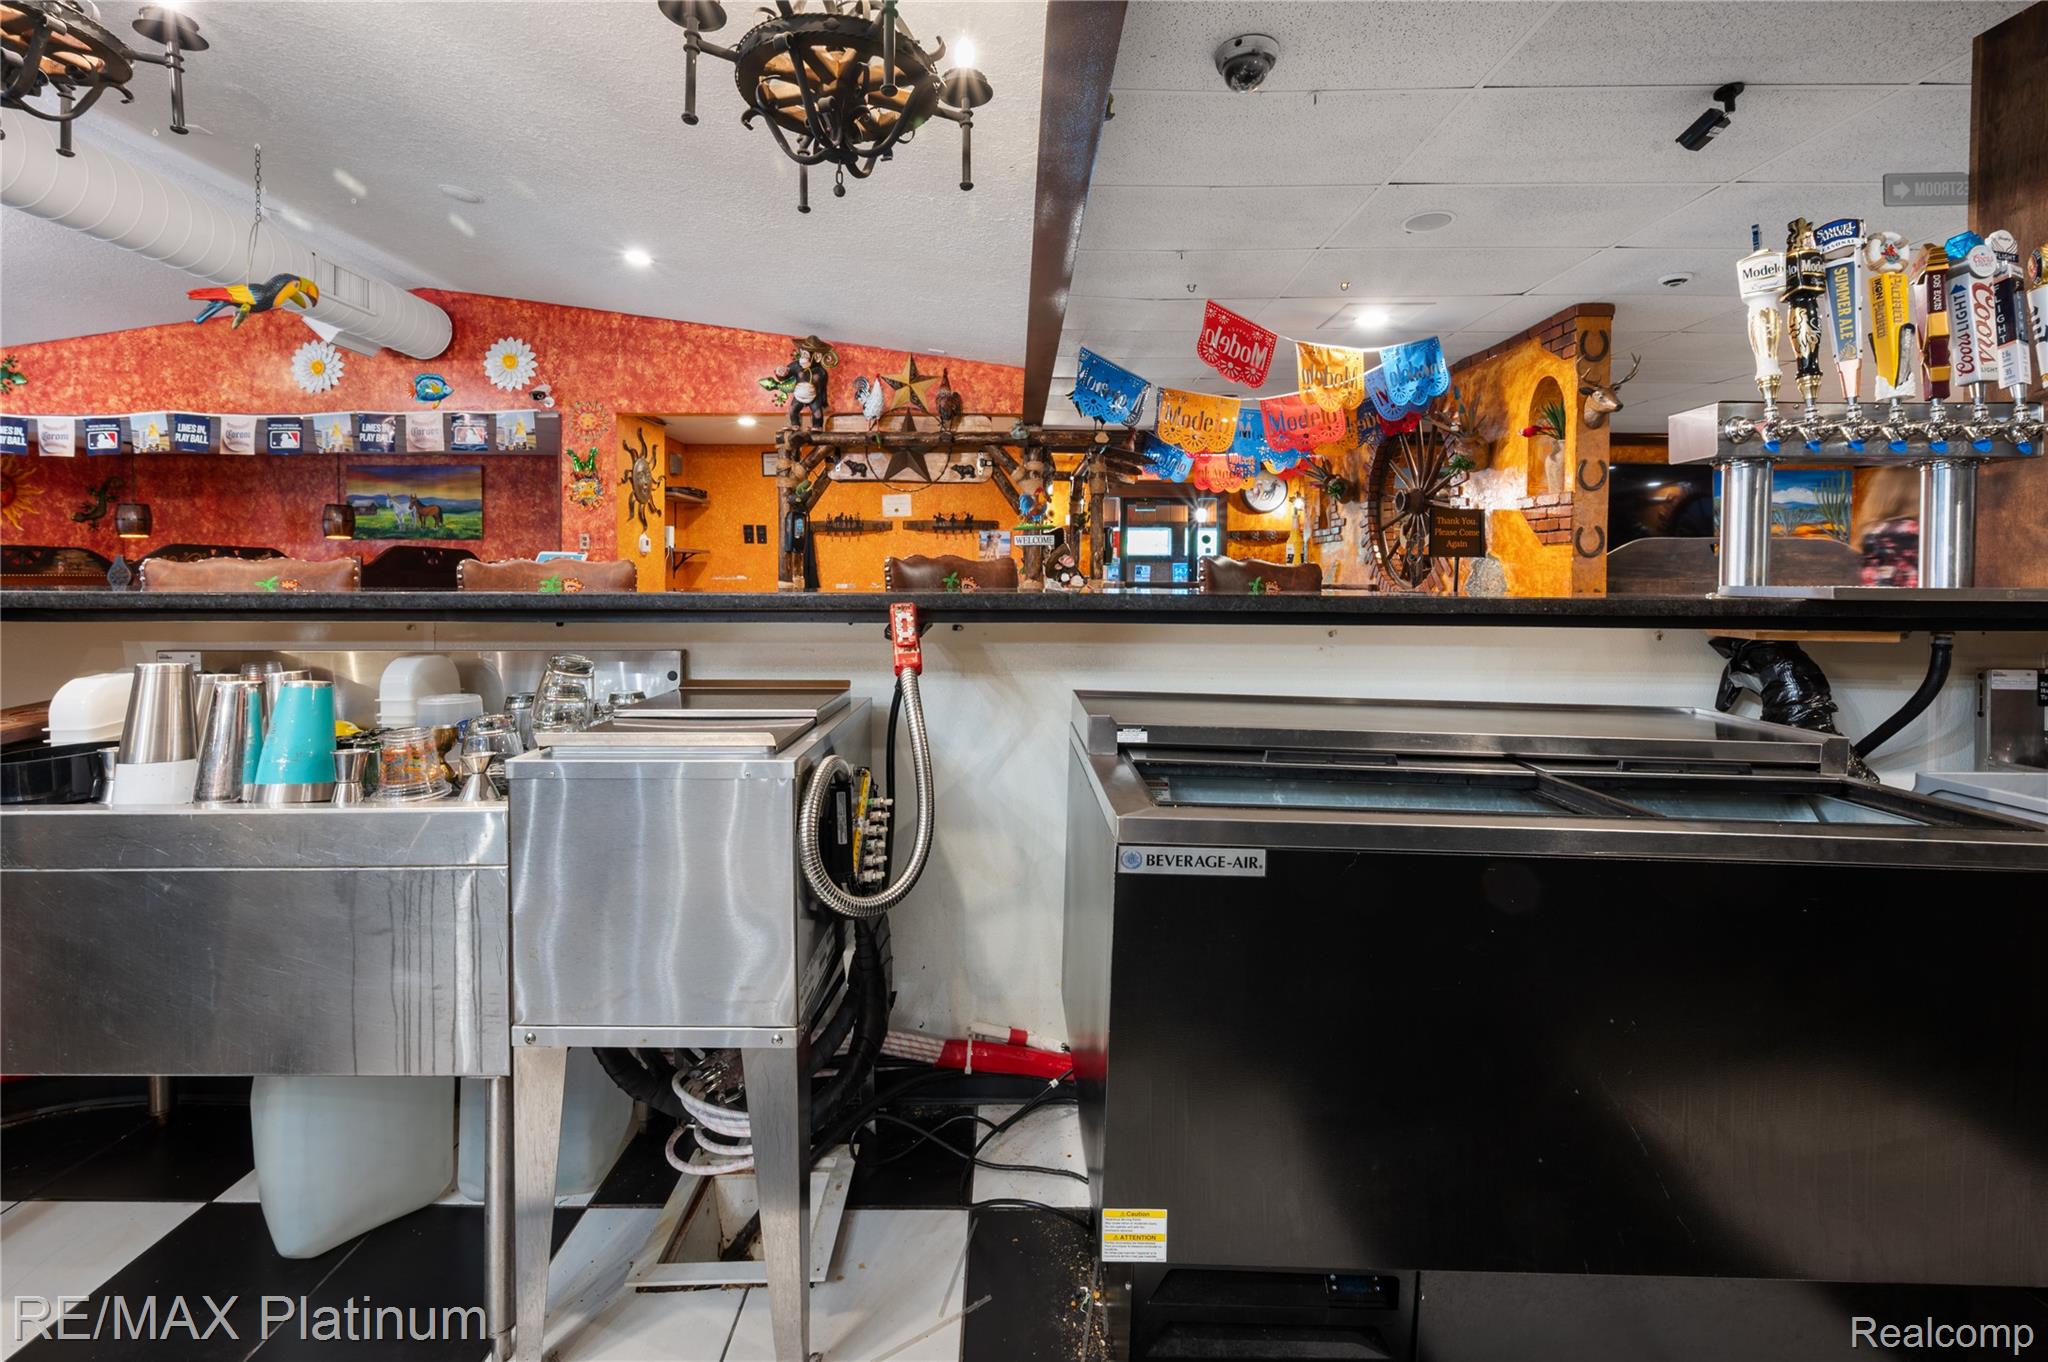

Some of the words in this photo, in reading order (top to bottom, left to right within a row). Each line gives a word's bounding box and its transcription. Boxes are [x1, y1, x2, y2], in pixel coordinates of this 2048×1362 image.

[1816, 221, 1856, 239] SAMUEL
[1820, 229, 1854, 243] ADAMS
[1743, 263, 1784, 279] Modelo
[1932, 274, 1942, 288] DOS
[1834, 266, 1852, 316] SUMMER
[1933, 290, 1942, 311] EQUIS
[1955, 293, 1969, 333] LIGHT
[1839, 318, 1854, 340] ALE
[1971, 281, 1996, 366] Coors
[1956, 333, 1975, 376] Coors
[1268, 408, 1338, 433] Modelo
[177, 423, 197, 433] LIMES
[361, 423, 381, 433] LIMES
[175, 432, 190, 442] PLAY
[360, 433, 375, 442] PLAY
[1436, 516, 1460, 525] Thank
[1435, 528, 1457, 536] Please
[1459, 528, 1479, 537] Come
[1015, 536, 1054, 545] WELCOME
[1446, 540, 1468, 549] Again
